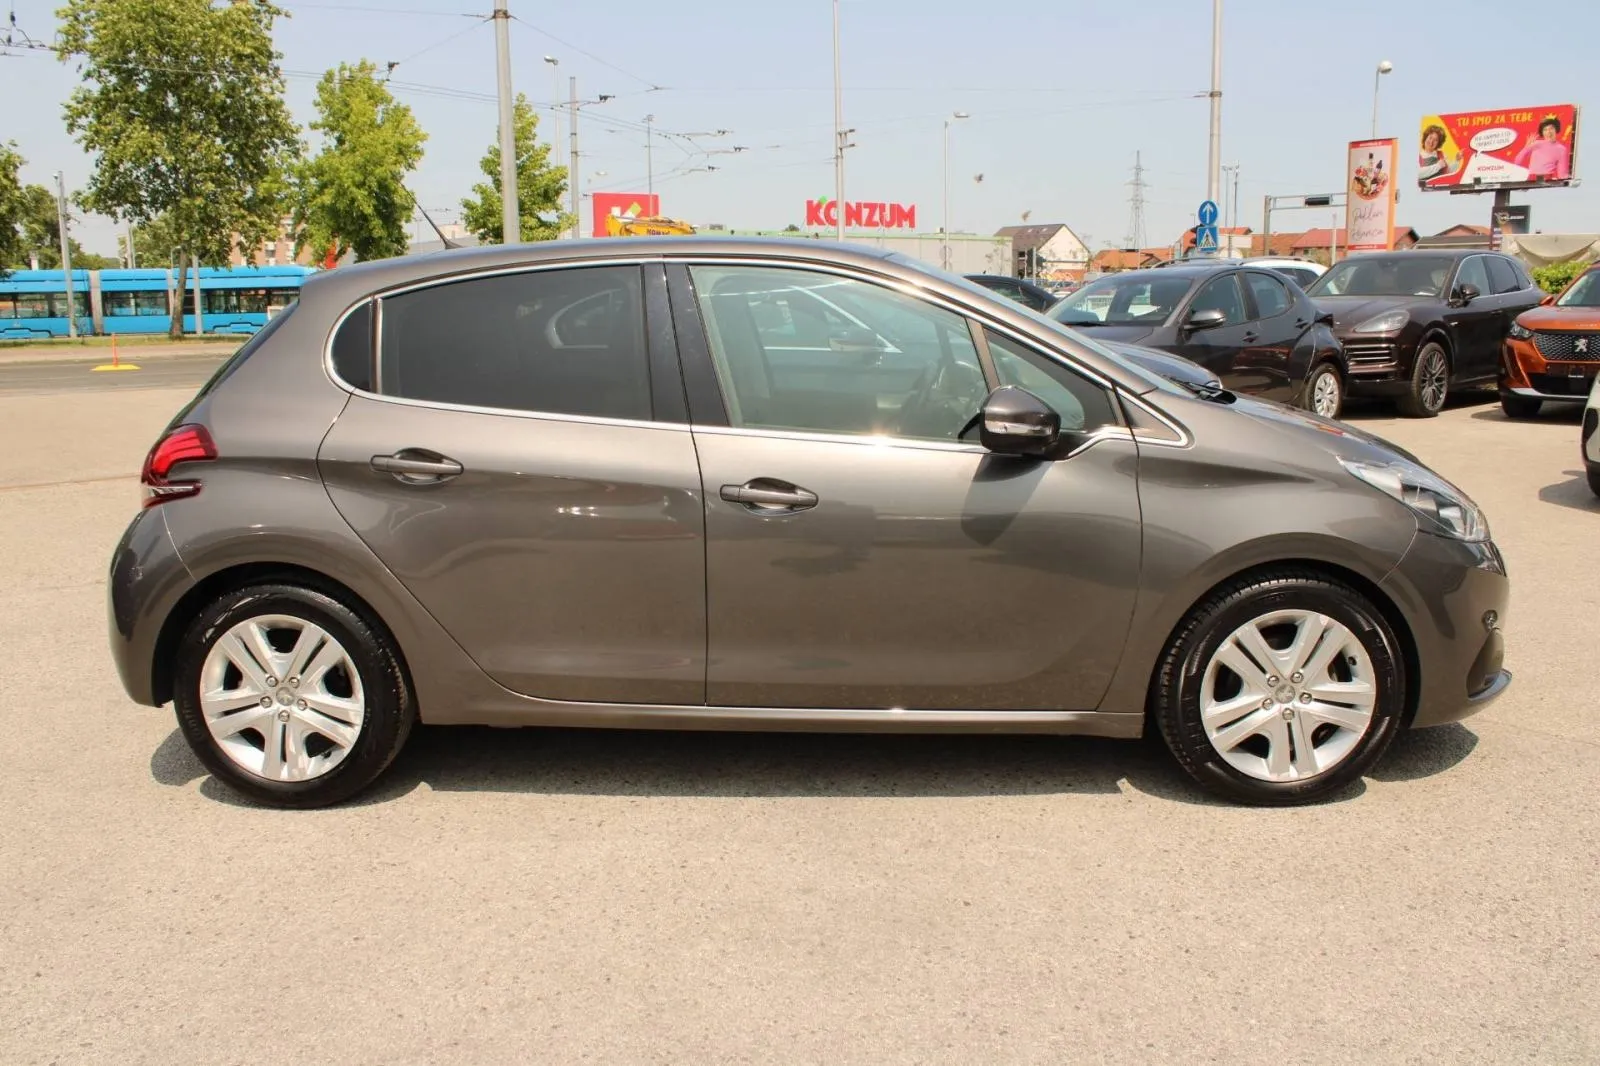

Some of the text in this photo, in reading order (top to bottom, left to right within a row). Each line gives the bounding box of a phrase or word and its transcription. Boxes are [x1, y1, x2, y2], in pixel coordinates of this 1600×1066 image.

[1456, 112, 1534, 127] TU SMO ZA TEBE
[1477, 164, 1505, 172] KONZUM
[806, 196, 916, 228] KONZUM
